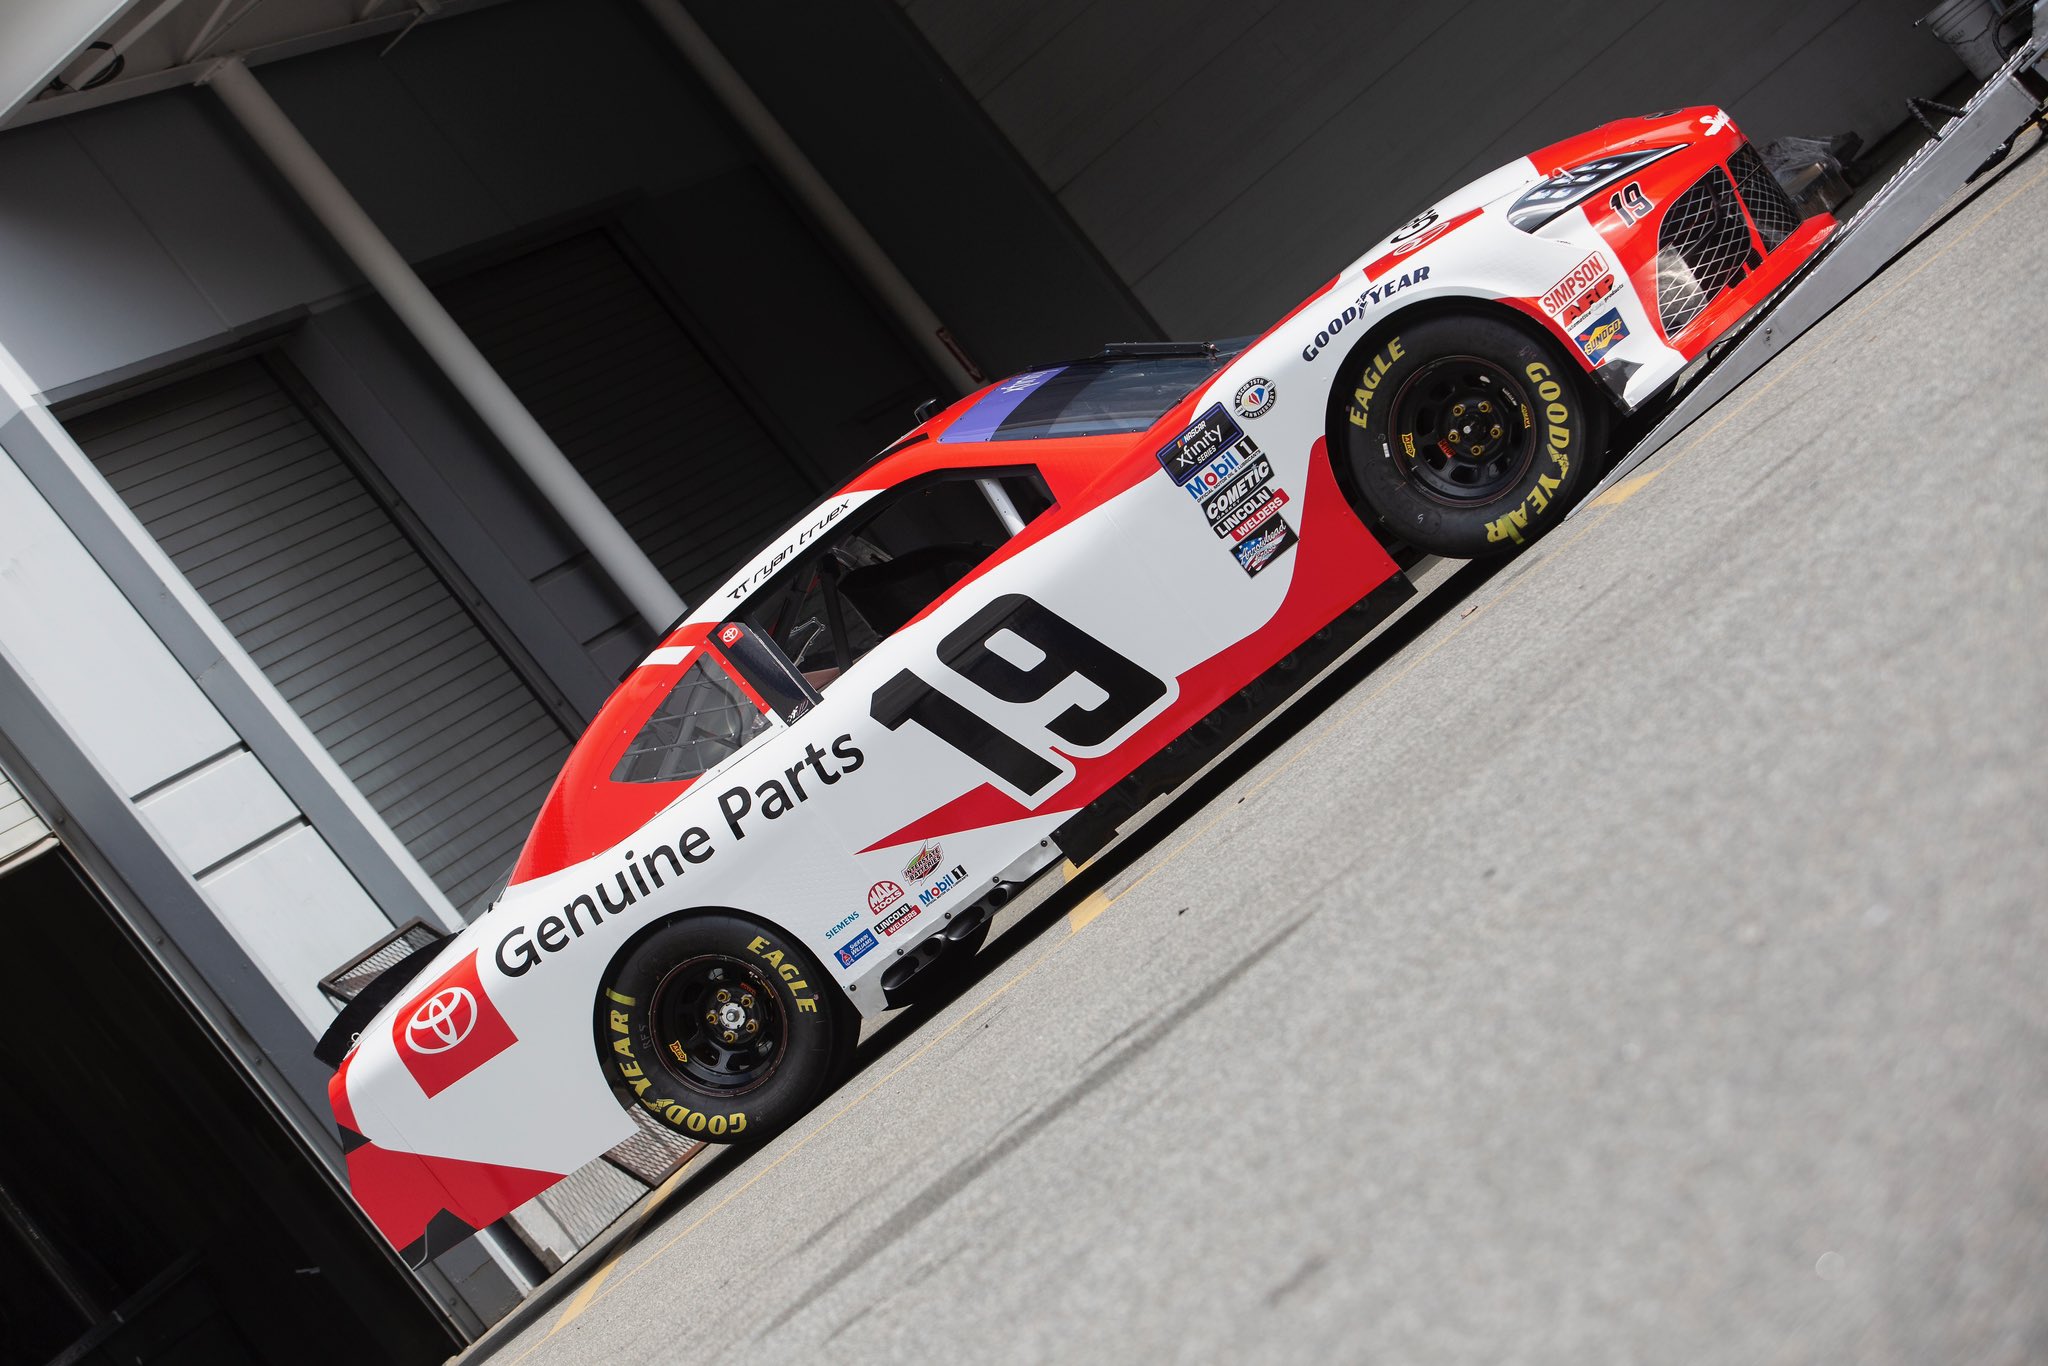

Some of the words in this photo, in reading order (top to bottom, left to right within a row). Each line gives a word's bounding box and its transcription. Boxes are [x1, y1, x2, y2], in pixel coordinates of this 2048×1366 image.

[1610, 182, 1654, 228] 19
[1543, 255, 1604, 314] SIMPSON
[1562, 274, 1615, 328] ARP
[1302, 266, 1431, 362] GOODYEAR
[1585, 319, 1621, 353] SUNOCO
[1349, 336, 1406, 429] EAGLE
[1176, 424, 1223, 468] xfinity
[1184, 420, 1207, 443] NASCAR
[1484, 361, 1571, 544] GOODYEAR
[1185, 451, 1240, 500] Mobil
[1240, 440, 1253, 458] 1
[1197, 445, 1217, 465] SERIES
[1197, 489, 1214, 503] OFFICIAL
[1213, 478, 1228, 489] MOTOR
[1207, 460, 1270, 520] COMETIC
[1216, 490, 1272, 536] LINCOLN
[1236, 497, 1284, 536] WELDERS
[753, 545, 794, 580] ryan
[799, 499, 850, 545] truex
[1240, 519, 1287, 563] Arrowhead
[869, 593, 1168, 797] 19
[495, 826, 716, 979] Genuine
[717, 733, 865, 841] Parts
[905, 846, 940, 877] INTERSTATE
[910, 855, 941, 881] BATTERIES
[871, 882, 896, 908] MAC
[873, 888, 902, 913] TOOLS
[918, 874, 955, 905] Mobil
[825, 910, 860, 940] SIEMENS
[875, 905, 910, 933] LINCOLN
[888, 909, 918, 934] WELDERS
[849, 933, 869, 951] SHERWIN
[850, 937, 873, 956] WILLIAMS
[746, 935, 818, 1013] EAGLE
[610, 1009, 747, 1136] GOODYEAR
